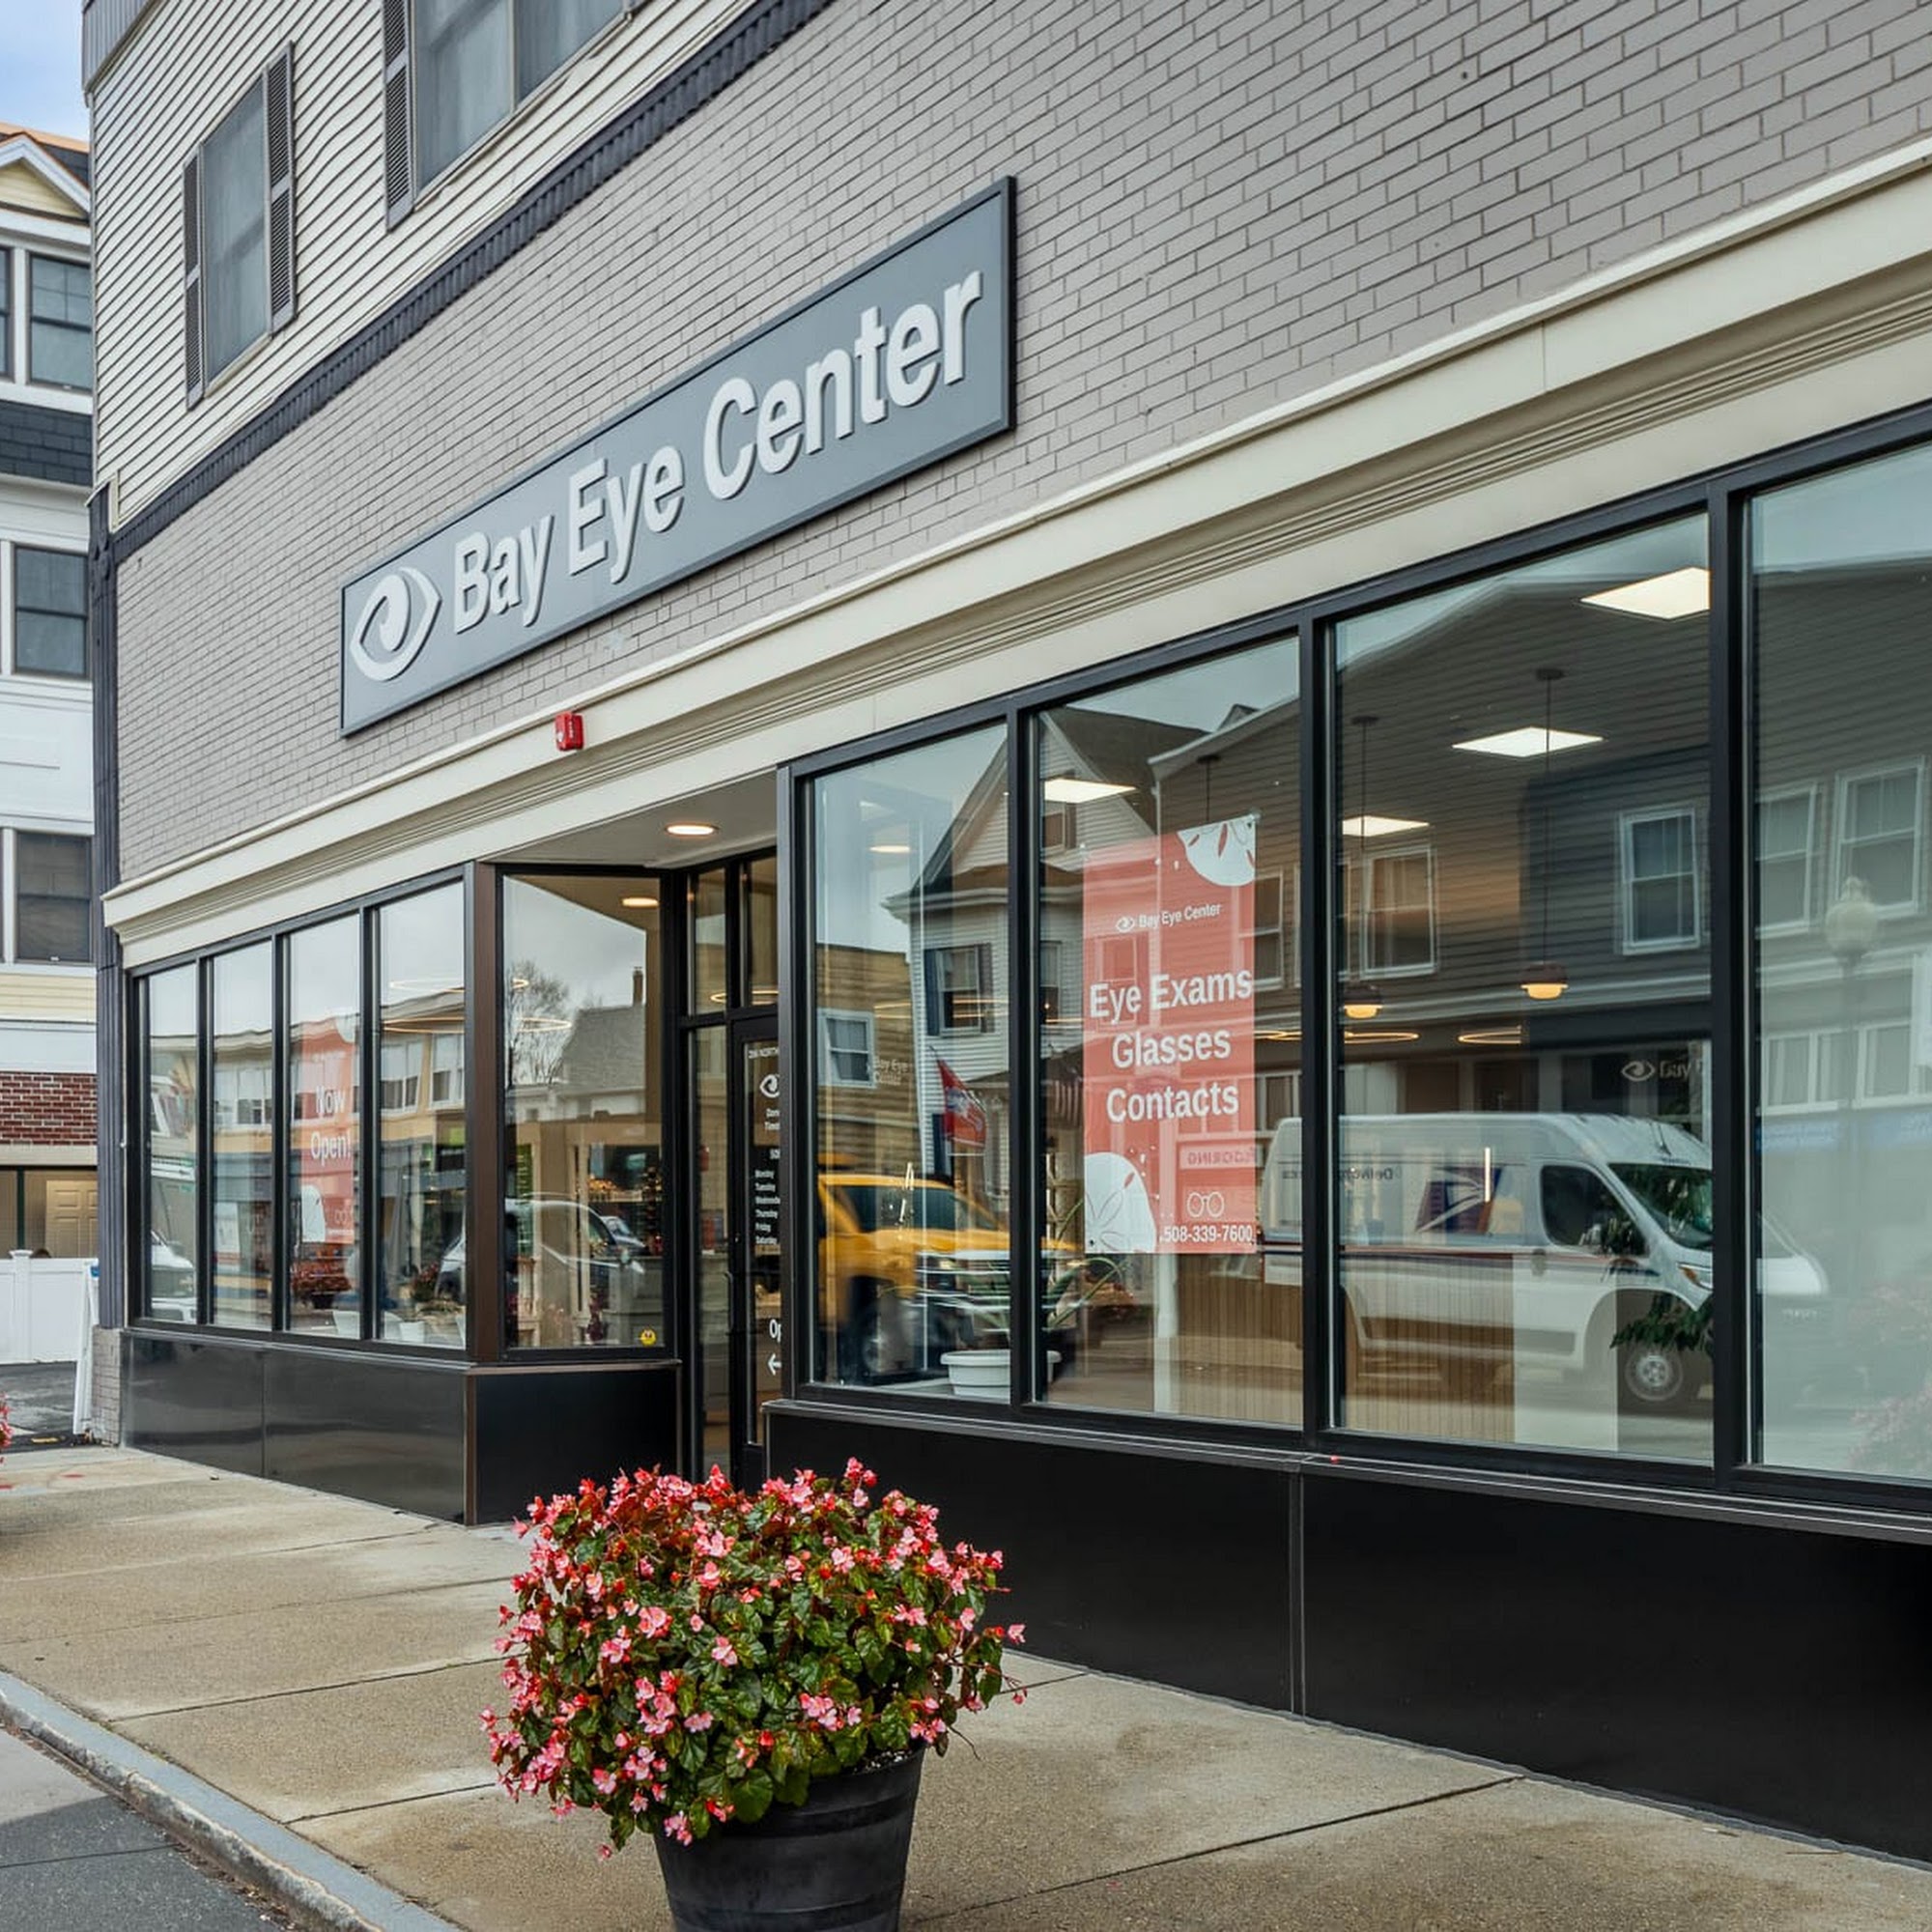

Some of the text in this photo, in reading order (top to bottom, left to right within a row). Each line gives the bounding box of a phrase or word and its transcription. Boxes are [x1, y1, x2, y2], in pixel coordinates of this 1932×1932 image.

[453, 270, 981, 635] Bay Eye Center
[1139, 903, 1222, 929] Bay Eye Center
[1090, 970, 1254, 1025] Eye Exams
[1112, 1029, 1232, 1069] Glasses
[316, 1085, 346, 1115] Now
[1106, 1082, 1239, 1123] Contacts
[310, 1129, 352, 1167] Open!
[1163, 1224, 1254, 1243] 508-339-7600
